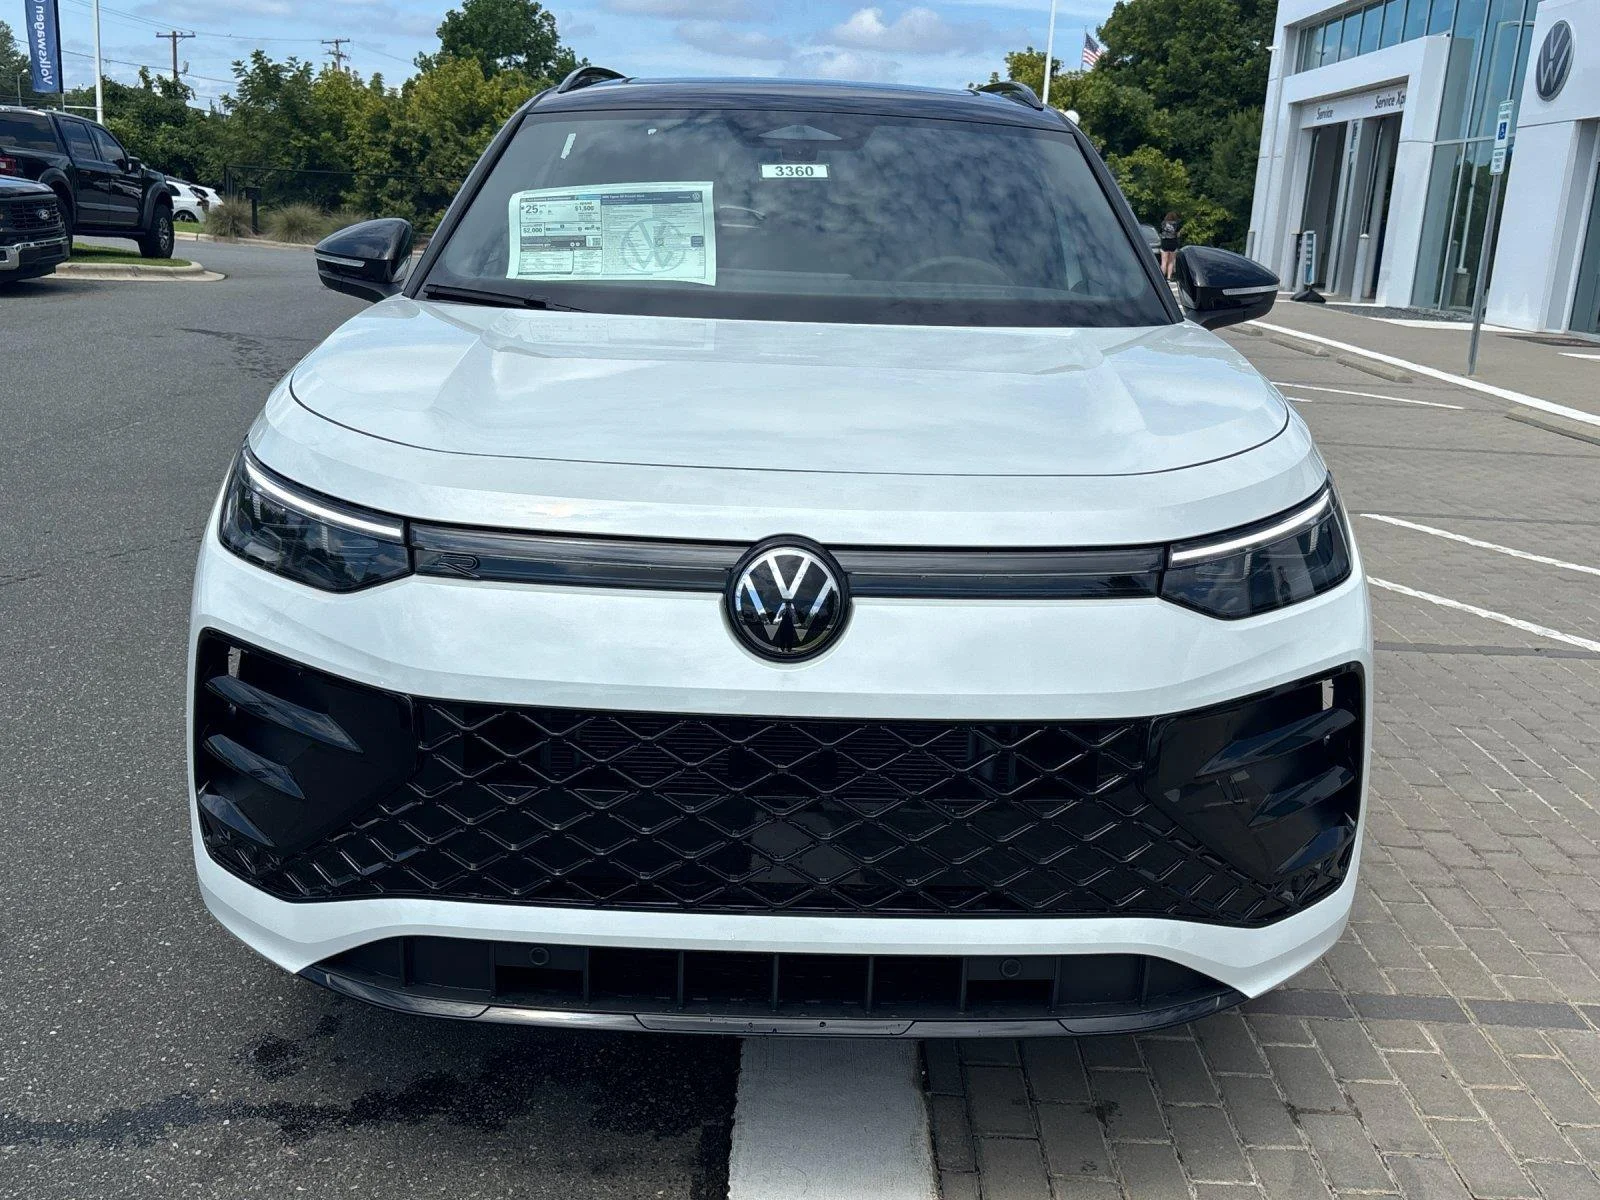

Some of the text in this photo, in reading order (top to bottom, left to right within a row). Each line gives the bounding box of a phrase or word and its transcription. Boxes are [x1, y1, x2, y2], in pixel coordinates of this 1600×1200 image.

[1374, 93, 1395, 109] Service
[1316, 106, 1334, 120] Service
[775, 165, 814, 177] 3360
[525, 205, 539, 214] 25
